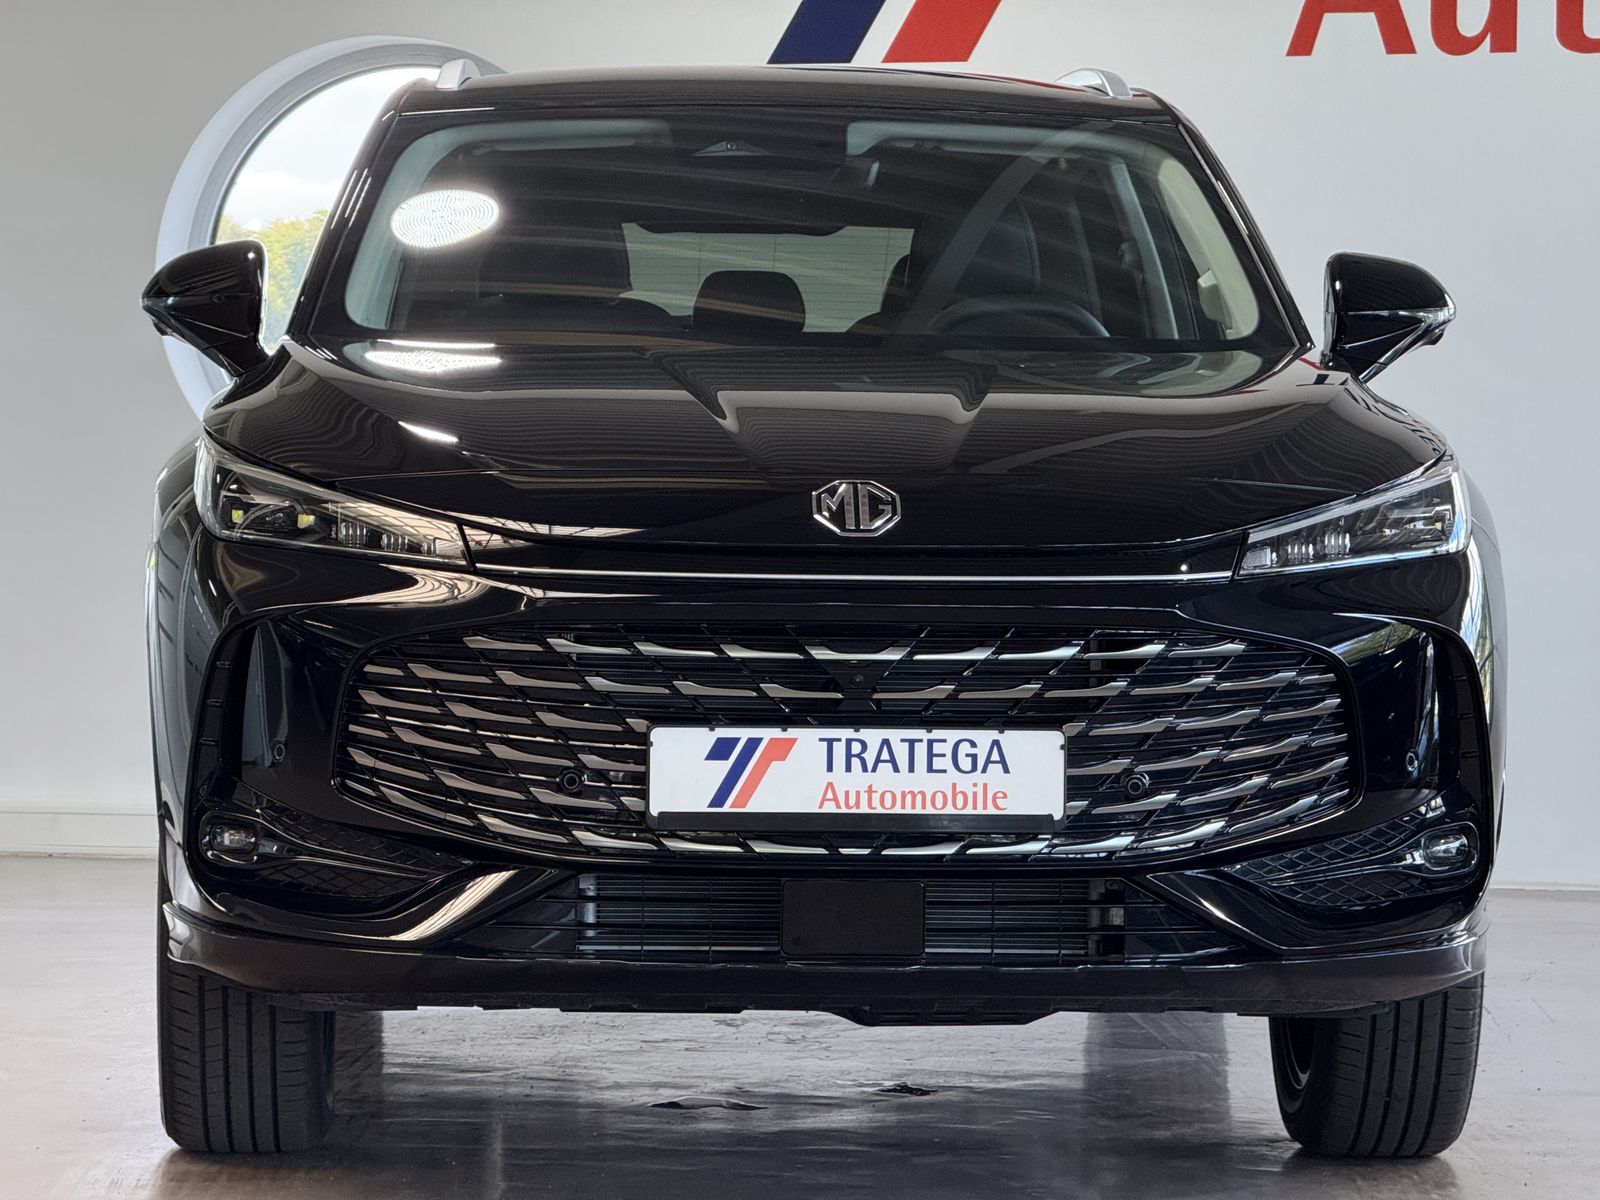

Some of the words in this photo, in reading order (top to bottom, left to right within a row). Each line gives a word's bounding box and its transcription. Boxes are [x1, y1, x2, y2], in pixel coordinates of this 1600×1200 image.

[820, 483, 892, 530] MG
[818, 737, 1011, 775] TRATEGA
[818, 781, 1009, 811] Automobile
